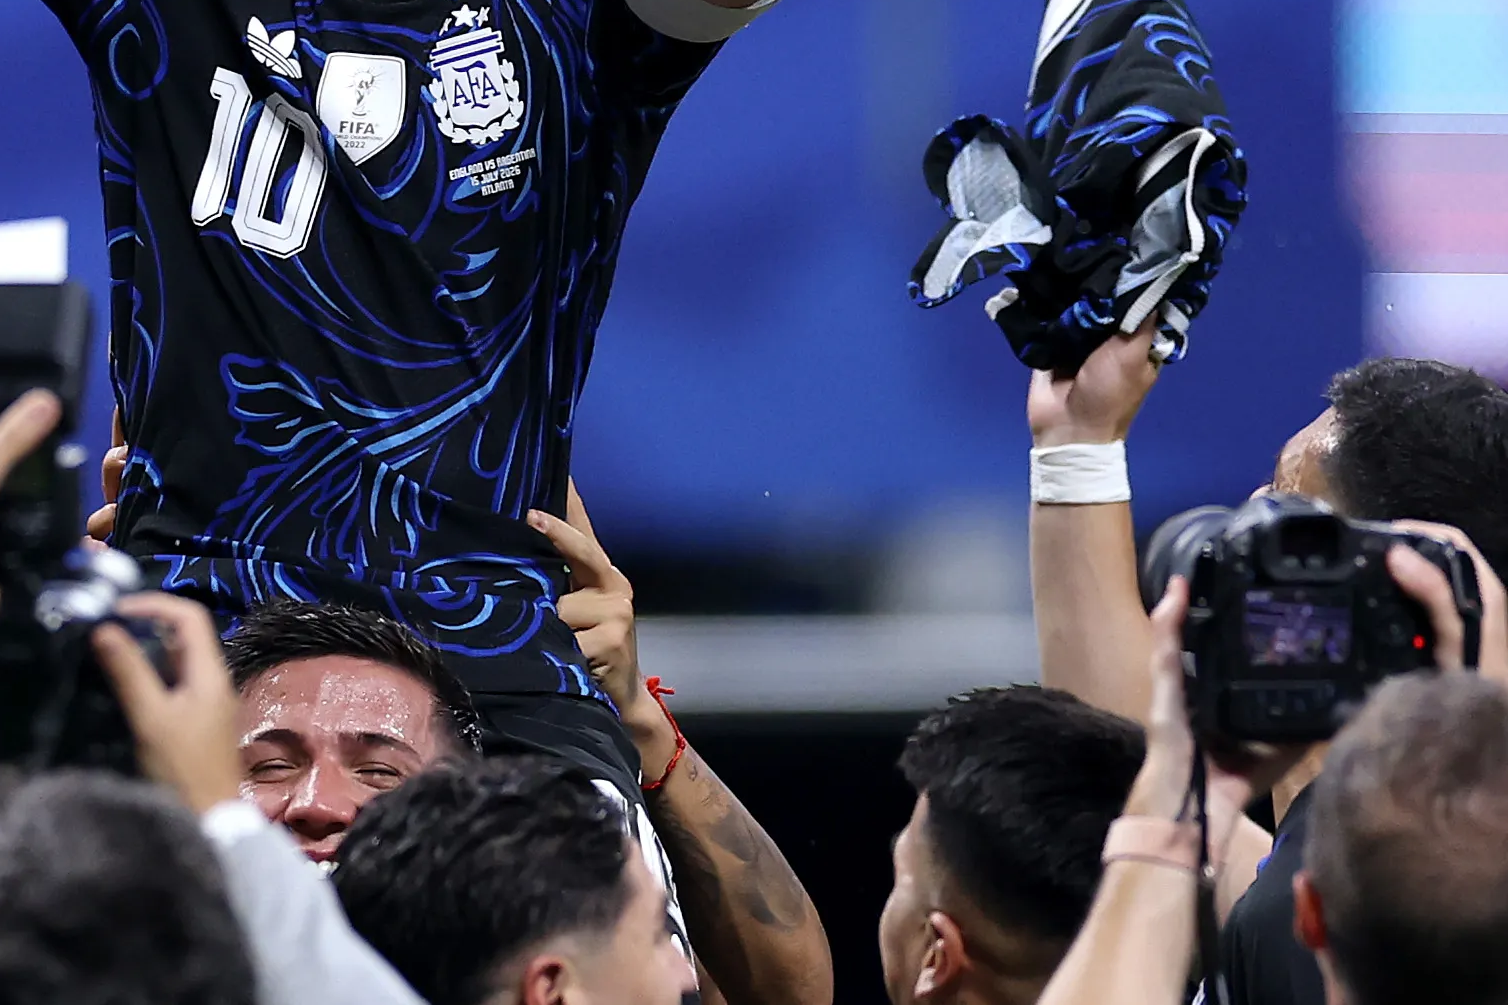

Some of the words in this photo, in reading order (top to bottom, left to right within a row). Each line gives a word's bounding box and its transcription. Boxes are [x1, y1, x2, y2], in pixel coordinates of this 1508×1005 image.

[452, 60, 501, 109] AFA
[339, 121, 375, 135] FIFA
[344, 140, 366, 149] 2022
[191, 66, 328, 260] 10
[449, 162, 484, 181] ENGLAND
[484, 159, 496, 171] VS
[496, 148, 536, 168] ARGENTINA
[471, 176, 480, 186] 15
[481, 170, 499, 184] JULY
[500, 165, 521, 179] 2026
[481, 179, 515, 196] ATLANTA
